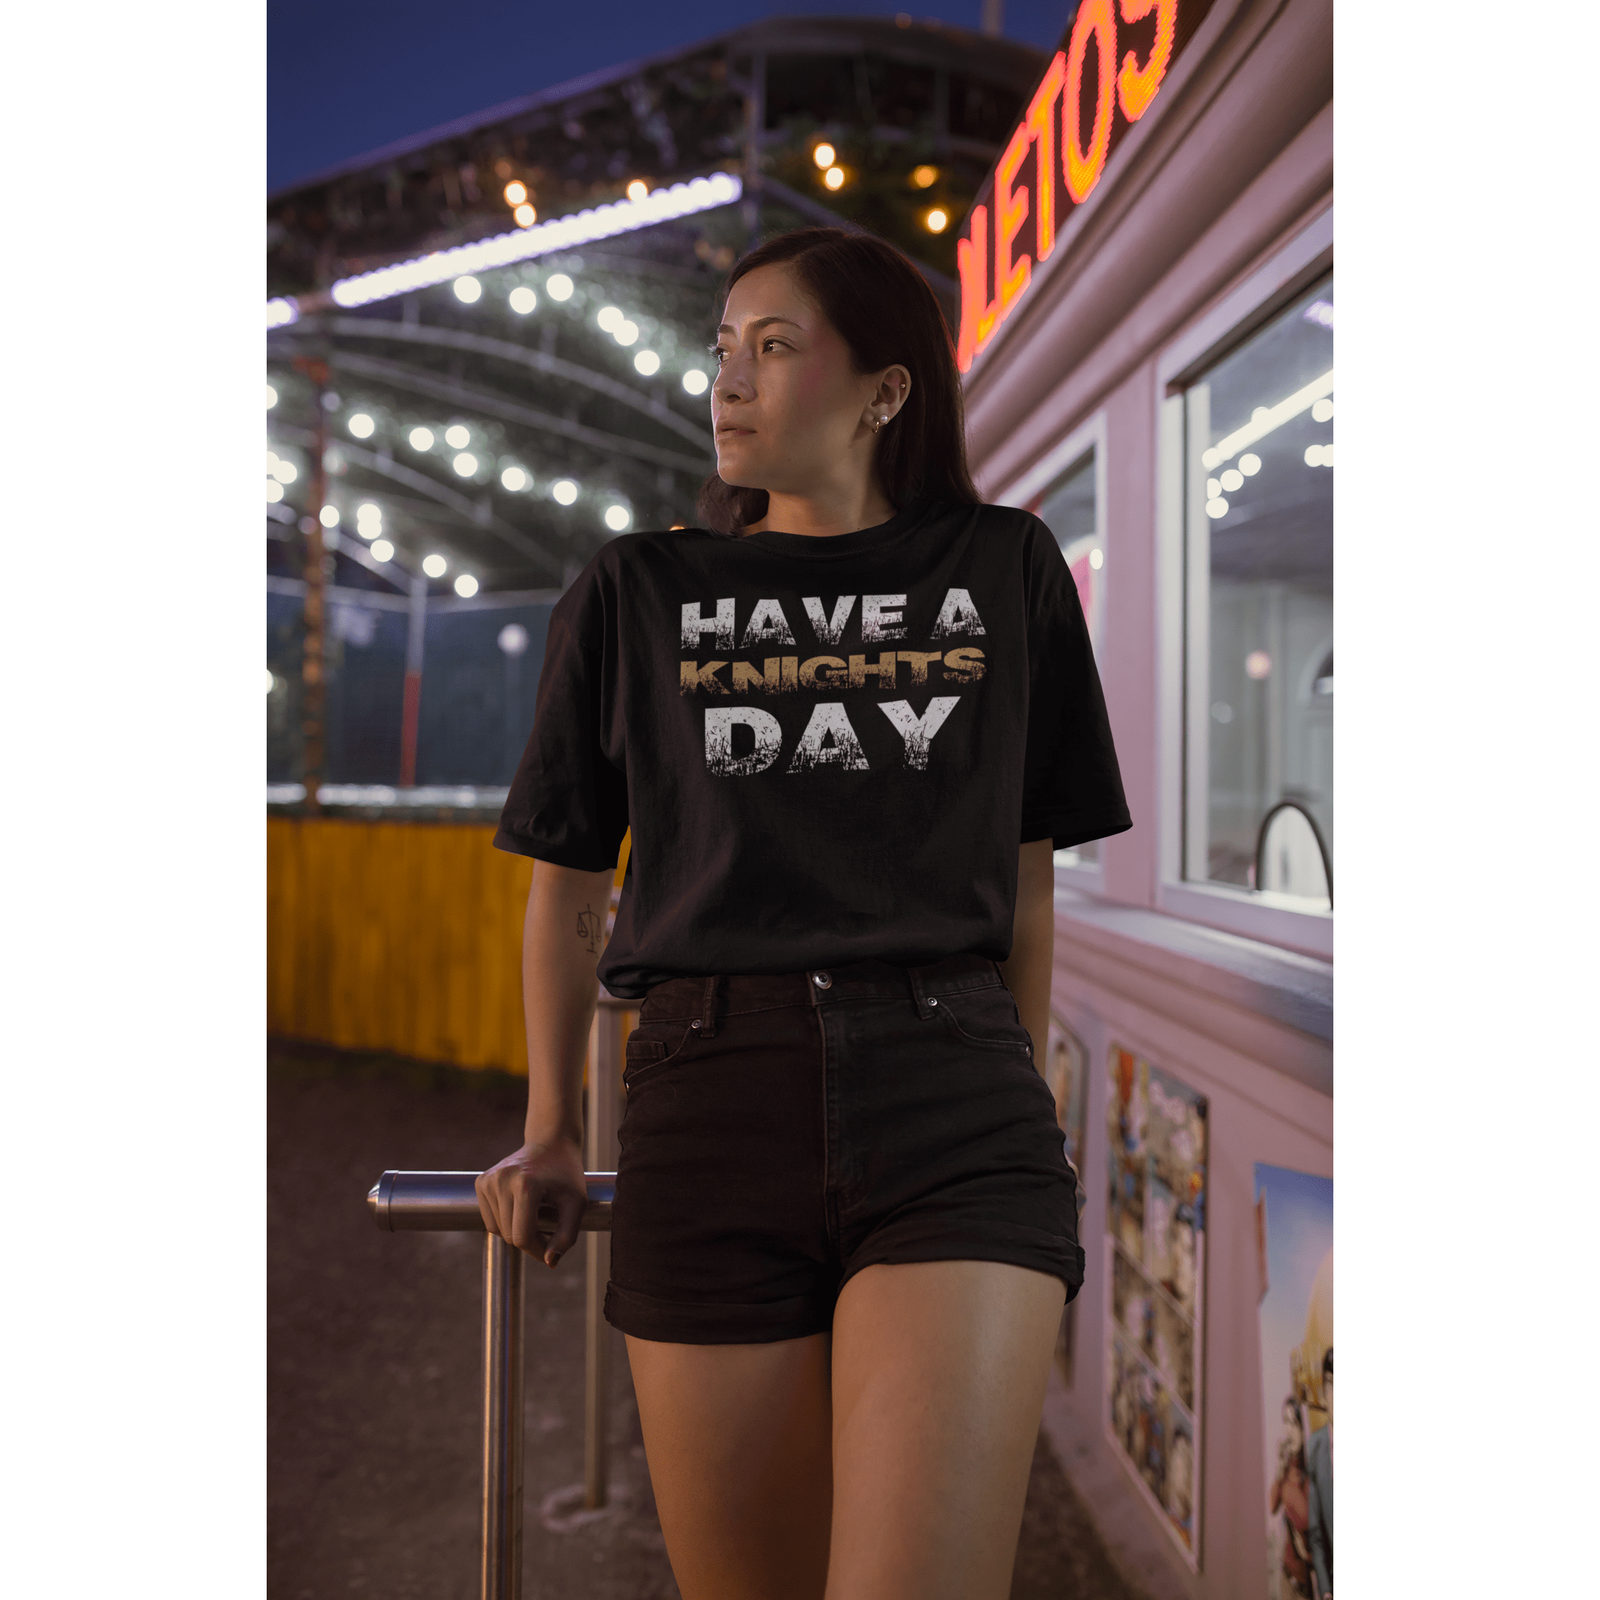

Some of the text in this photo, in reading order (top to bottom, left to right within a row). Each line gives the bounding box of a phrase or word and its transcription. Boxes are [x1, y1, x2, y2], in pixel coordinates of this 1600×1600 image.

[680, 588, 987, 650] HAVE A
[680, 647, 987, 696] KNIGHTS
[704, 696, 962, 777] DAY
